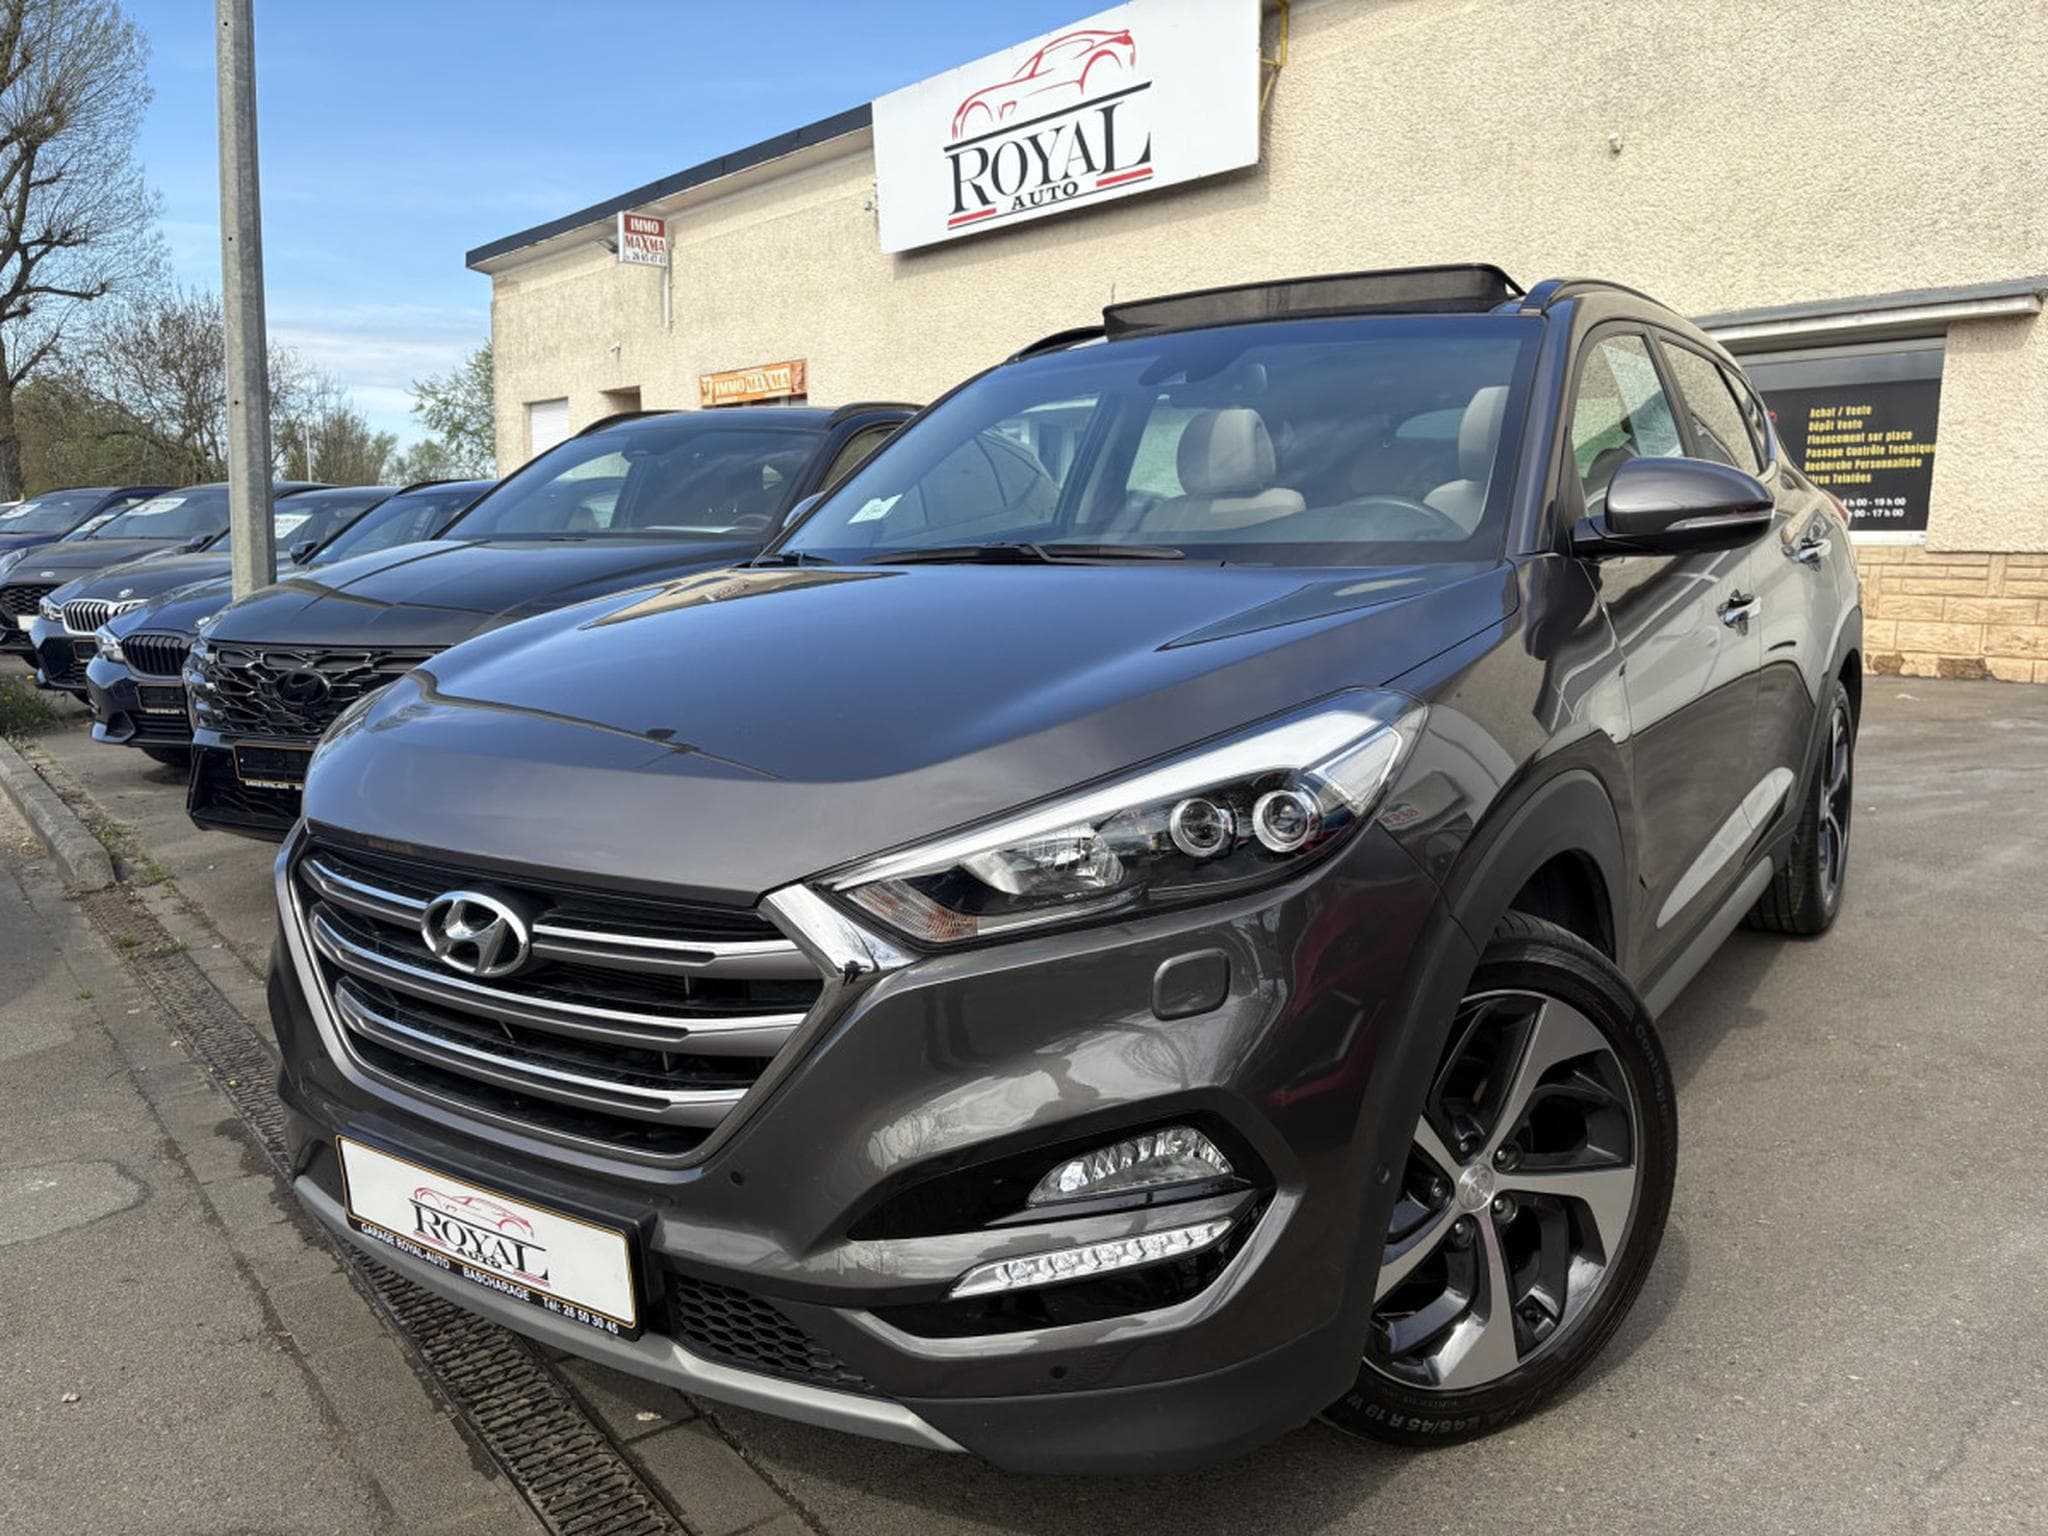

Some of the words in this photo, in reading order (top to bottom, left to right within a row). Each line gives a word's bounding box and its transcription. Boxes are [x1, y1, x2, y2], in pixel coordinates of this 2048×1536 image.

[945, 100, 1151, 215] ROYAL
[1011, 181, 1079, 210] AUTO
[630, 217, 660, 234] IMMO
[1809, 407, 1836, 418] Achat
[1845, 405, 1872, 416] Vente
[1808, 420, 1834, 432] Dépôt
[1837, 419, 1863, 430] Vente
[1806, 432, 1865, 445] Financement
[1867, 431, 1884, 442] sur
[1885, 430, 1913, 442] place
[1805, 446, 1844, 458] Passage
[1845, 444, 1886, 456] Contrôle
[1804, 460, 1852, 472] Recherche
[1854, 457, 1922, 470] Personnalisée
[1894, 496, 1906, 506] 00
[1872, 508, 1883, 518] 17
[1892, 507, 1904, 517] 00
[413, 1204, 549, 1281] ROYAL
[456, 1247, 502, 1270] AUTO
[361, 1222, 395, 1247] GARAGE
[462, 1267, 531, 1302] BASCHARAGE
[577, 1310, 590, 1324] 50
[605, 1321, 619, 1335] 45
